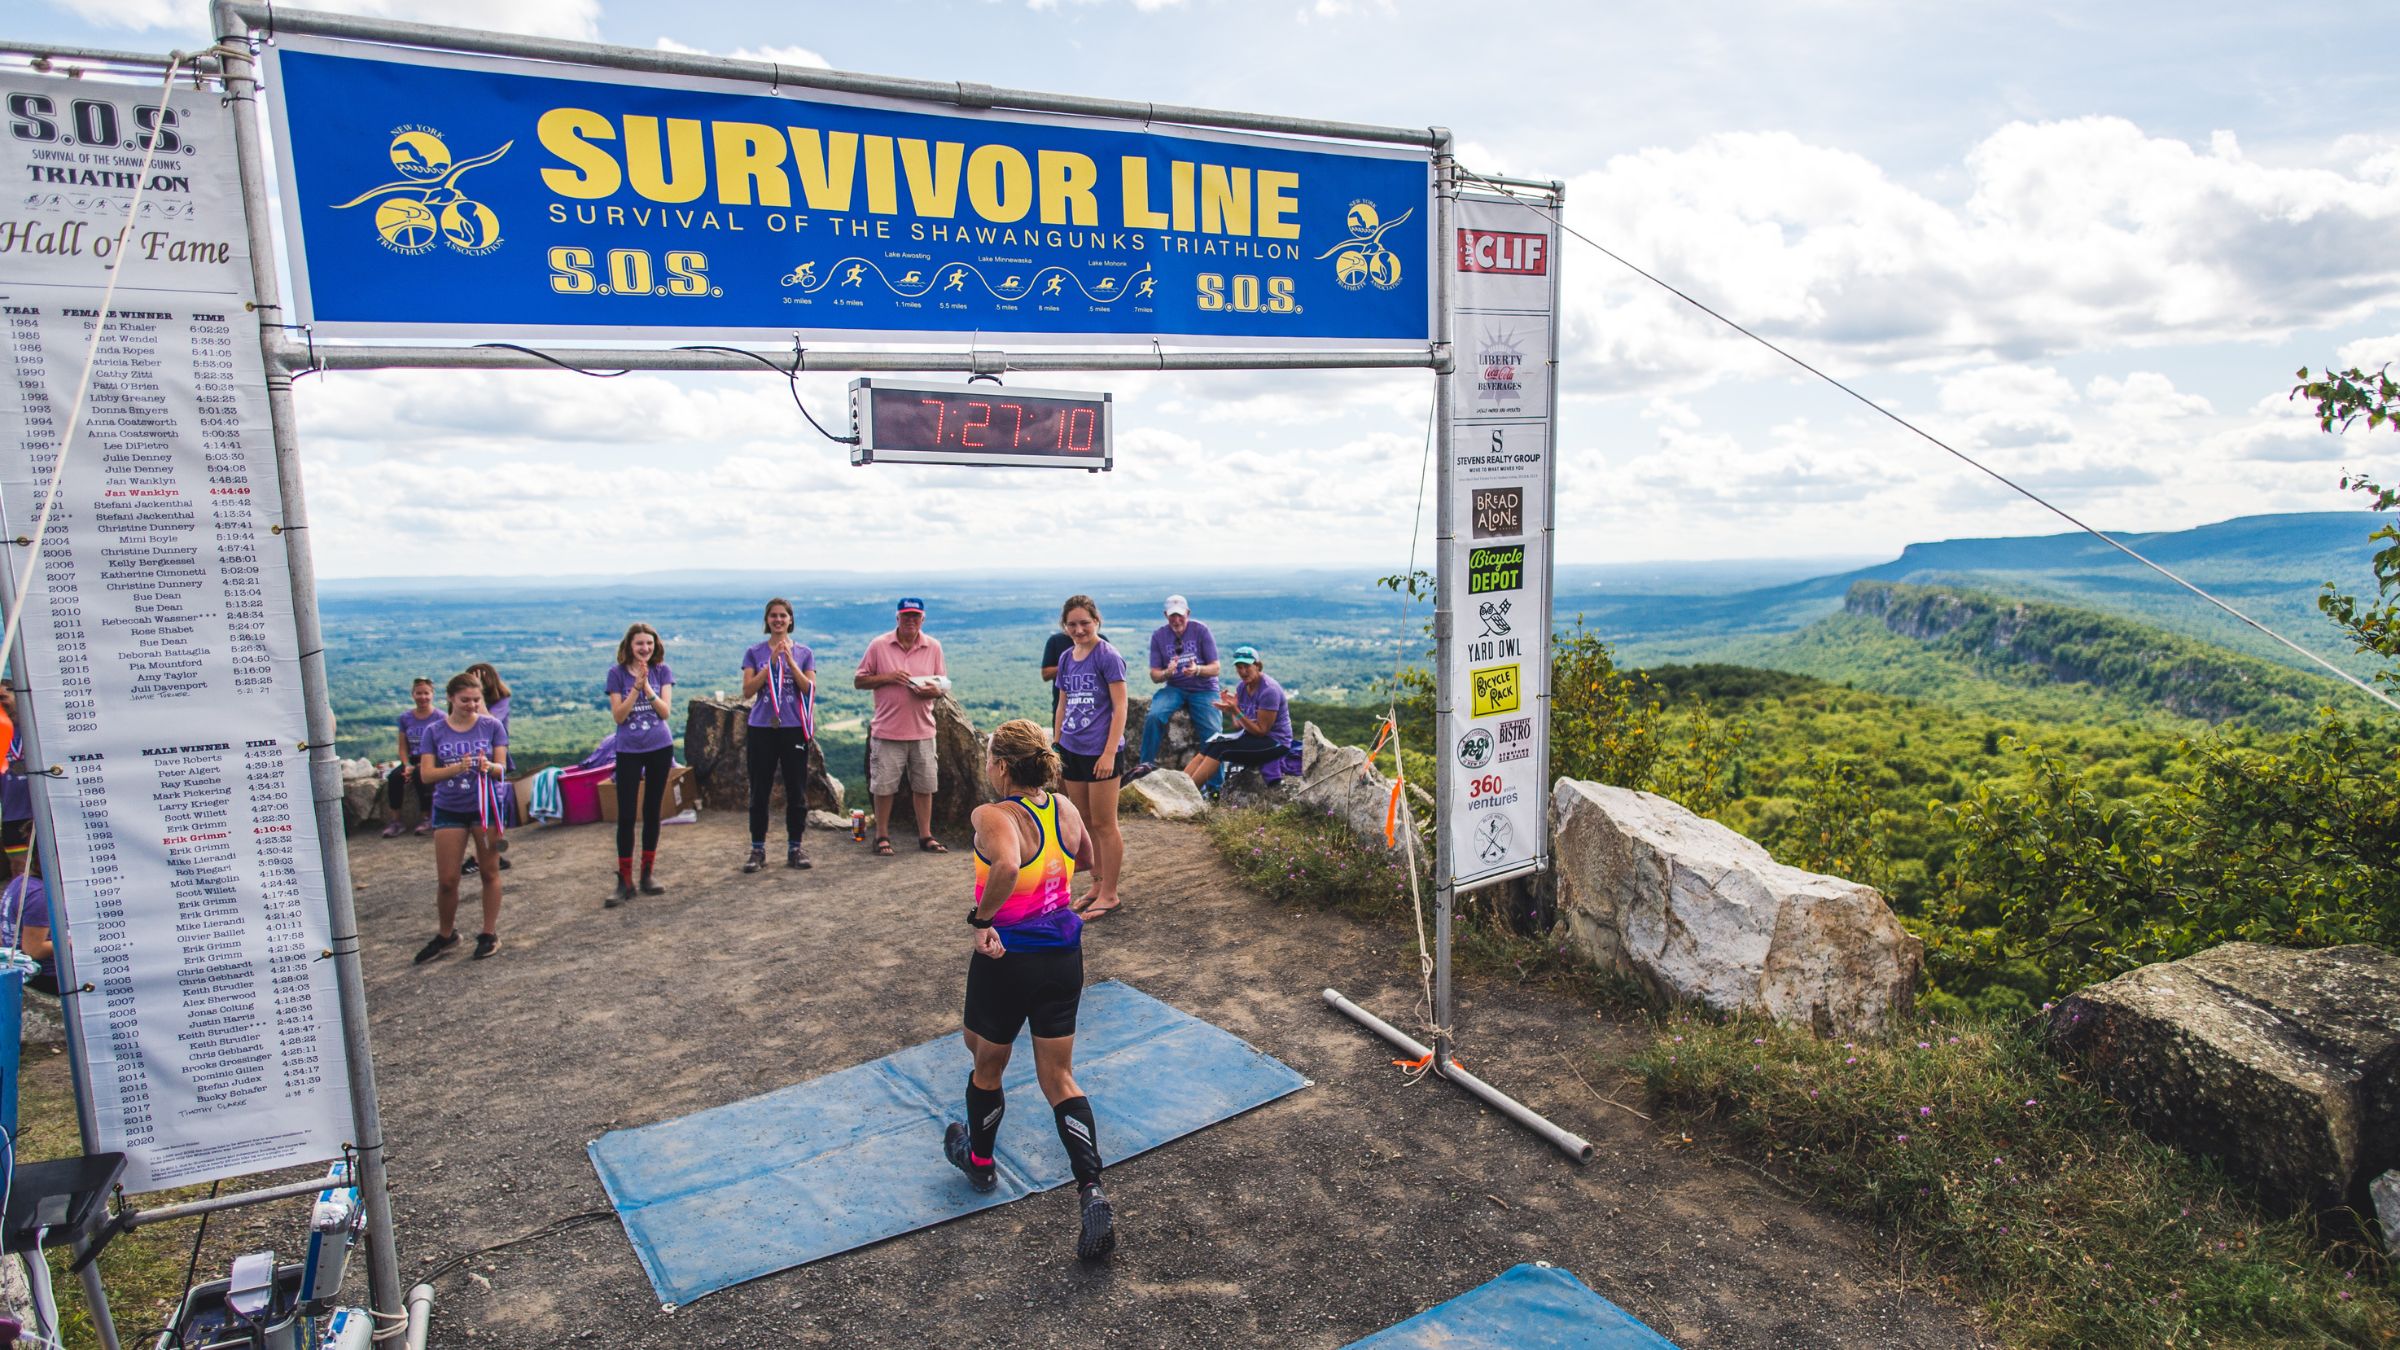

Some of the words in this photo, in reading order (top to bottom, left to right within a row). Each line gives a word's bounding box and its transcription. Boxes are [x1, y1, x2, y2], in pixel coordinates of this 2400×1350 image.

[7, 92, 196, 156] S.O.S.
[390, 124, 412, 136] NEW
[416, 124, 445, 139] YORK
[32, 149, 76, 162] SURVIVAL
[78, 152, 90, 163] OF
[94, 154, 110, 165] THE
[113, 156, 182, 171] SHAWAGUNKS
[537, 107, 1098, 226] SURVIVOR
[1122, 156, 1301, 240] LINE
[549, 202, 744, 231] SURVIVAL
[768, 214, 807, 232] OF
[830, 219, 890, 239] THE
[911, 223, 1145, 250] SHAWANGUNKS
[1162, 236, 1301, 260] TRIATHLON
[0, 220, 88, 256] Hall
[94, 225, 135, 270] of
[141, 231, 230, 264] Fame
[376, 235, 437, 255] TRIATHLETE
[444, 237, 505, 256] ASSOCIATION
[884, 251, 901, 259] Lake
[902, 252, 931, 261] Awosting
[1465, 234, 1474, 266] BAR
[1476, 236, 1542, 270] CLIF
[994, 256, 1033, 264] Minnewaska
[547, 246, 724, 298] S.O.S.
[1197, 272, 1304, 314] S.O.S.
[2, 306, 40, 315] YEAR
[119, 311, 173, 320] WINNER
[192, 314, 225, 322] TIME
[952, 302, 968, 310] miles
[1479, 354, 1522, 366] LIBERTY
[16, 368, 45, 376] 1990
[96, 370, 128, 379] Cathy
[194, 372, 234, 380] 5:22:33
[93, 382, 118, 390] Patti
[1478, 382, 1522, 390] BEVERAGES
[21, 393, 48, 401] 1992
[90, 395, 119, 404] Libby
[121, 394, 166, 404] Greaney
[922, 400, 1094, 451] 7:27:10
[1492, 429, 1503, 453] S
[30, 454, 58, 462] 1997
[102, 454, 130, 462] Julie
[132, 454, 172, 462] Denney
[205, 453, 244, 461] 5:03:30
[1457, 456, 1485, 465] STEVENS
[1487, 454, 1512, 464] REALTY
[1514, 454, 1540, 463] GROUP
[33, 490, 63, 498] 200
[128, 489, 180, 497] Wanklyn
[1477, 492, 1518, 510] BREAD
[1478, 508, 1518, 531] ALONE
[40, 538, 70, 547] 2004
[150, 536, 178, 544] Boyle
[216, 533, 254, 541] 5:19:44
[1470, 548, 1522, 572] Bicycle
[1472, 570, 1518, 592] DEPOT
[52, 608, 81, 616] 2010
[156, 604, 184, 612] Dean
[225, 600, 263, 608] 5:13:22
[58, 654, 88, 663] 2014
[118, 651, 162, 660] Deborah
[164, 648, 210, 656] Battaglia
[1468, 642, 1494, 662] YARD
[1498, 638, 1522, 658] OWL
[64, 688, 92, 698] 2017
[131, 685, 151, 693] Juli
[154, 681, 208, 692] Davenport
[1477, 671, 1510, 698] BICYCLE
[1490, 686, 1514, 709] RACK
[1500, 724, 1530, 744] BISTRO
[67, 753, 104, 762] YEAR
[141, 747, 178, 756] MALE
[180, 743, 230, 753] WINNER
[246, 739, 276, 748] TIME
[75, 764, 102, 773] 1984
[183, 755, 222, 764] Roberts
[244, 749, 282, 758] 4:43:26
[76, 776, 104, 785] 1985
[158, 770, 186, 778] Peter
[188, 766, 220, 775] Algert
[245, 761, 283, 770] 4:39:18
[1470, 775, 1502, 798] 360
[82, 810, 108, 819] 1990
[158, 803, 188, 811] Larry
[190, 799, 230, 808] Krieger
[250, 792, 288, 802] 4:34:50
[1468, 792, 1518, 811] ventures
[110, 1019, 138, 1029] 2009
[187, 1009, 217, 1018] Jonas
[220, 1003, 254, 1013] Colting
[275, 994, 311, 1005] 4:18:38
[123, 1104, 150, 1114] 2017
[196, 1093, 227, 1102] Bucky
[230, 1086, 267, 1097] Schafer
[284, 1076, 321, 1087] 4:31:39
